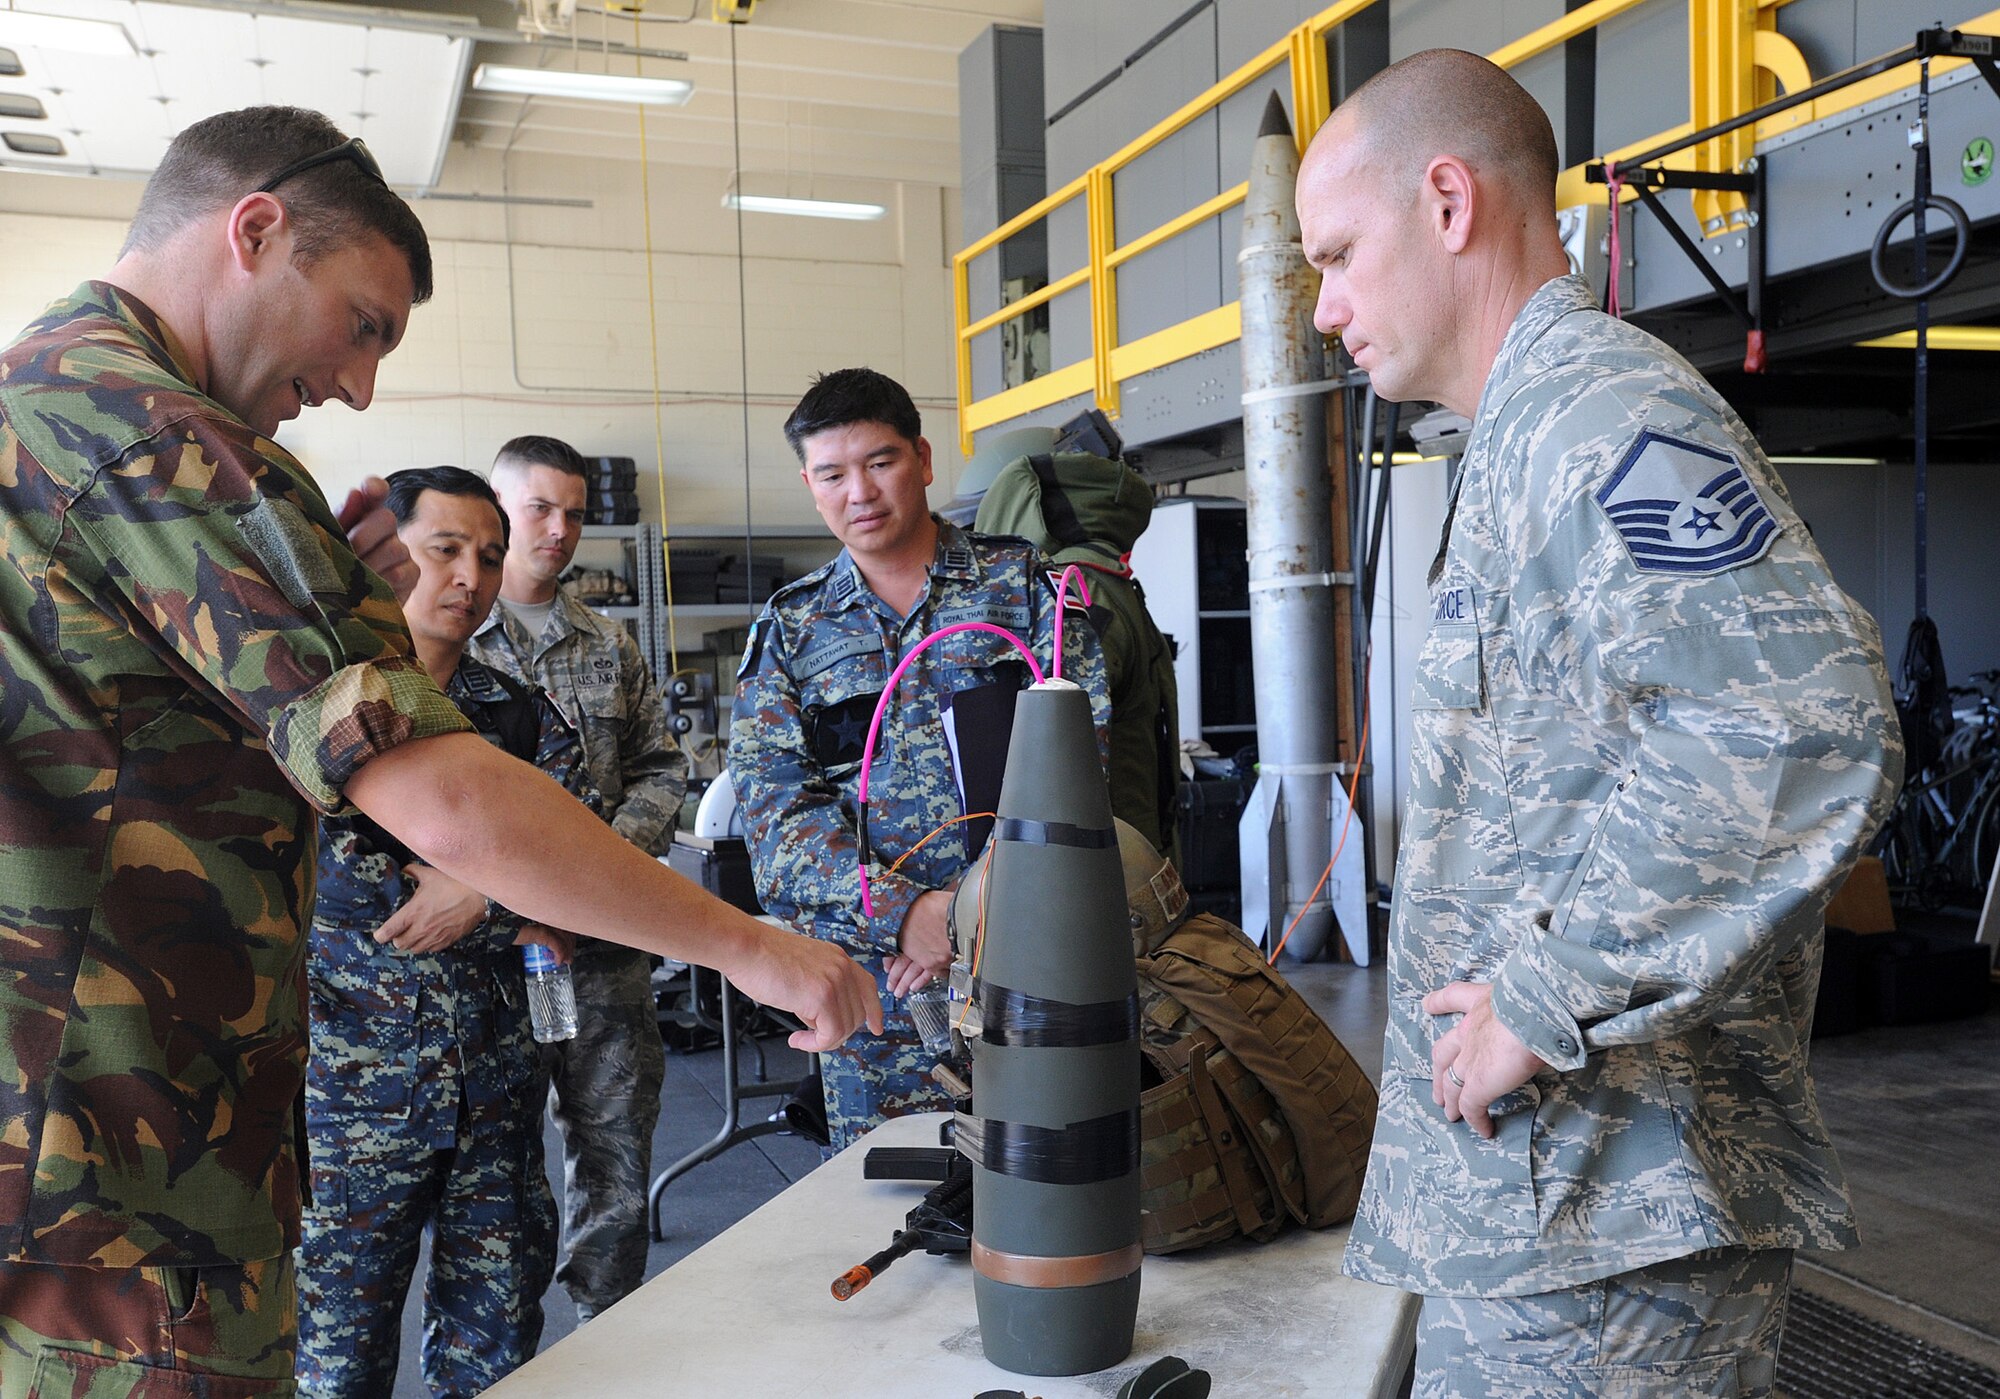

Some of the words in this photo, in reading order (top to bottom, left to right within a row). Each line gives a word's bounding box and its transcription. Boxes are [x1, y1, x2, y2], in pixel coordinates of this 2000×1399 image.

[942, 613, 966, 624] ROYAL
[966, 609, 984, 619] THAI
[986, 609, 999, 617] AIR
[1001, 611, 1025, 621] FORCE
[1435, 590, 1465, 620] ORCE
[808, 642, 849, 669] NATTAWAT
